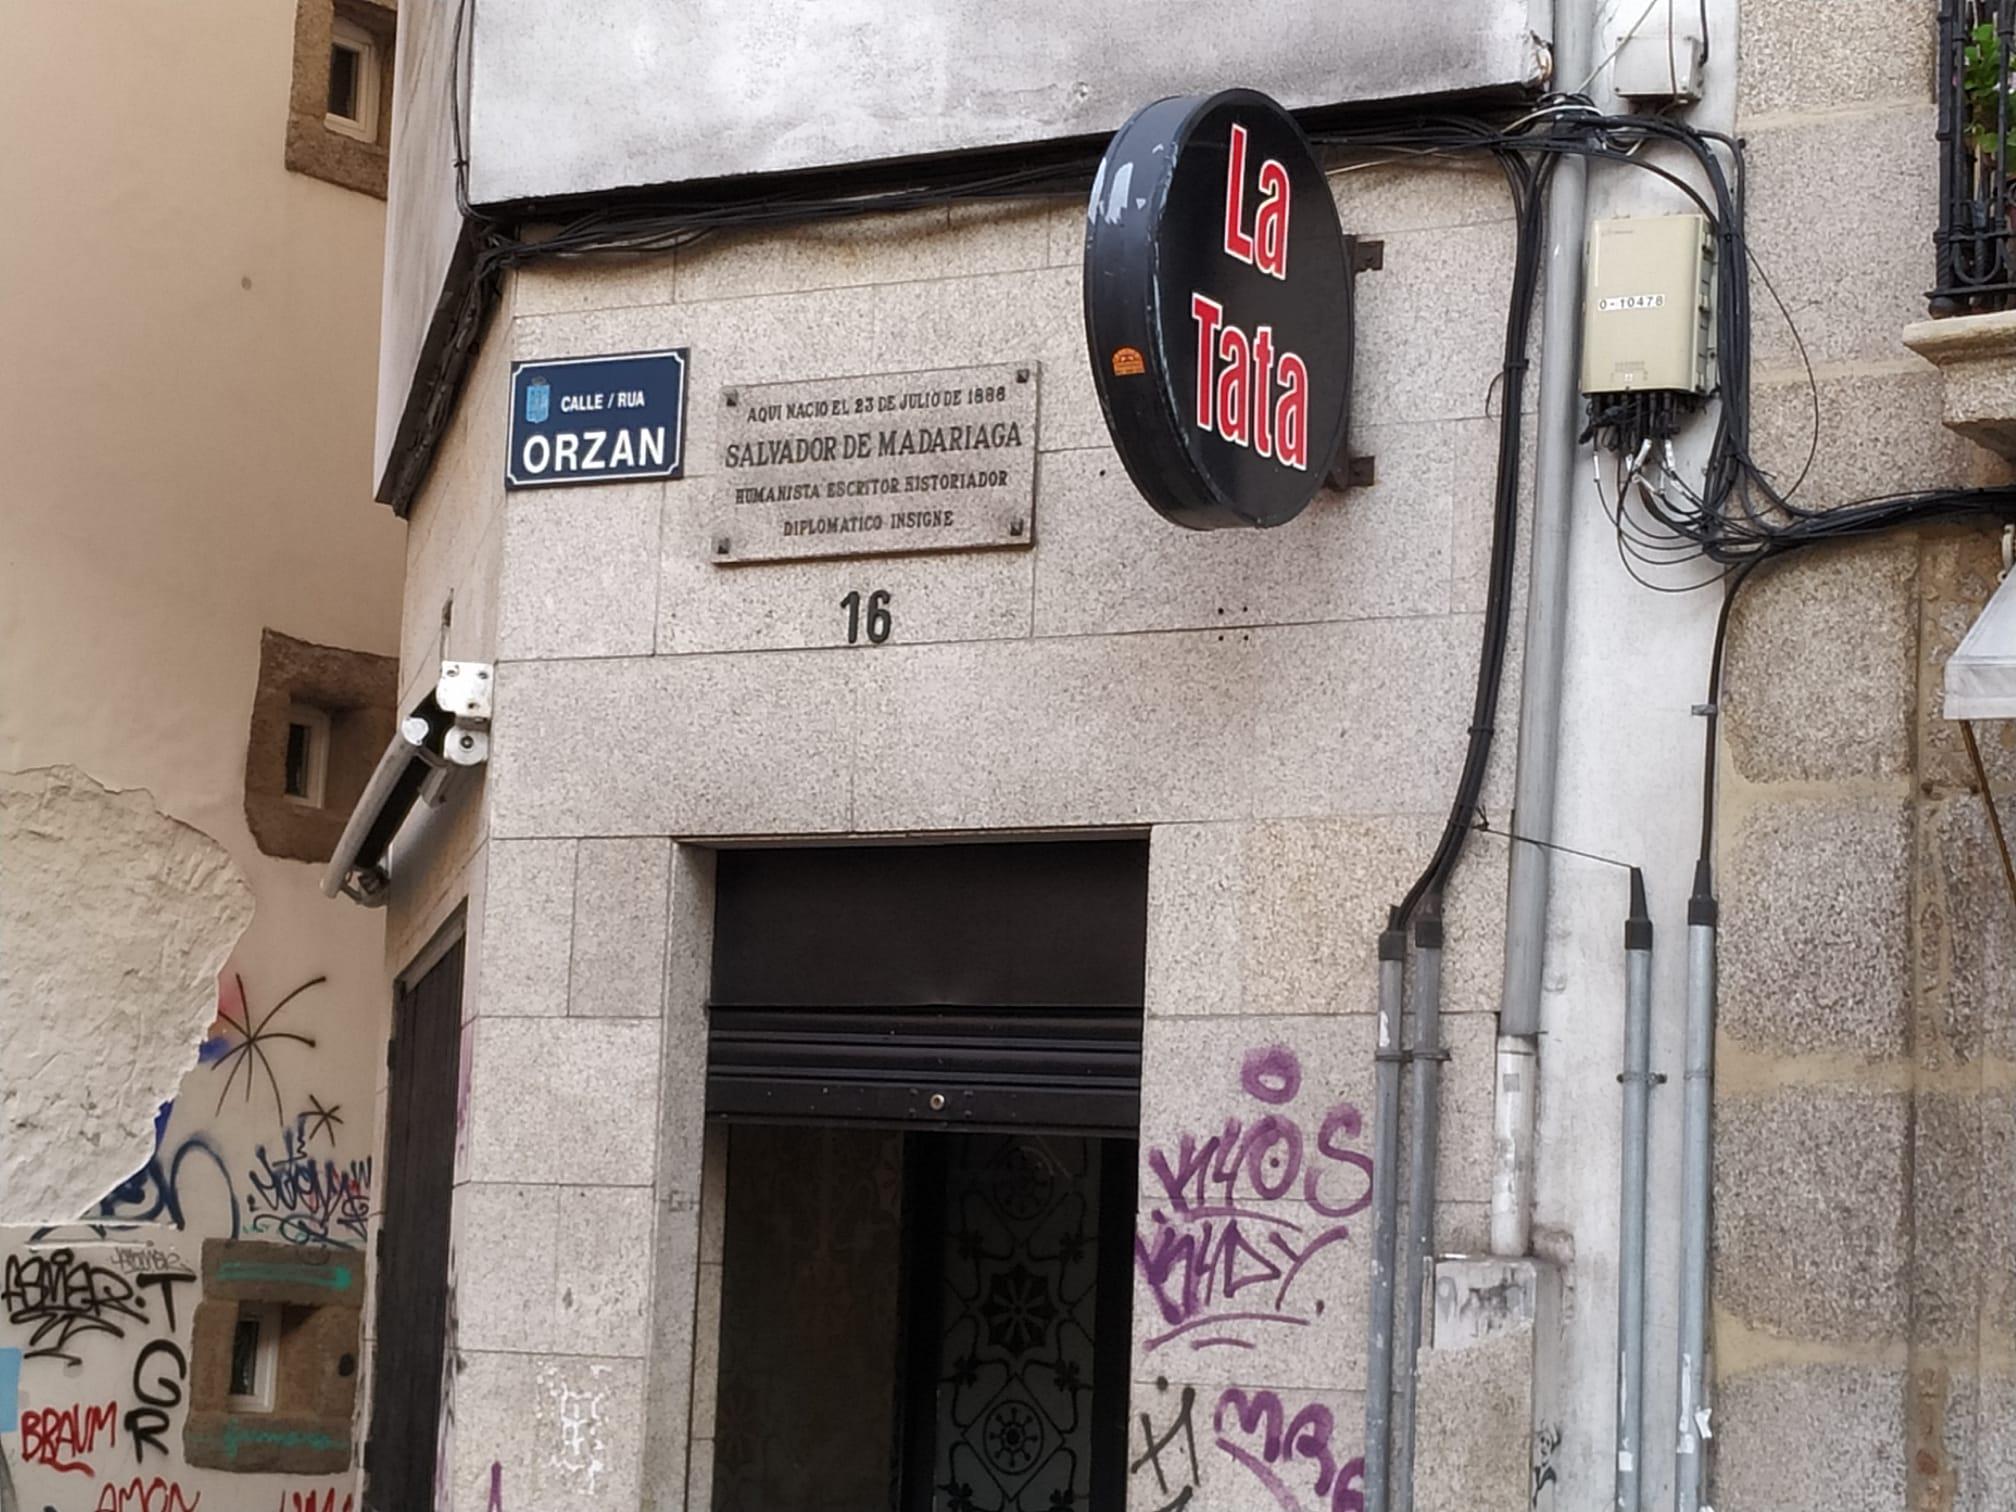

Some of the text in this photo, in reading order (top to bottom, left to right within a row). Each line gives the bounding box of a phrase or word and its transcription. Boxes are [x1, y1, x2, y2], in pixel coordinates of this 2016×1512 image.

[1224, 123, 1290, 280] La
[561, 394, 604, 412] CALLE
[617, 390, 645, 408] RUA
[1191, 292, 1309, 471] Tata
[747, 405, 782, 422] AQUI
[786, 400, 828, 419] NACIO
[832, 399, 849, 415] EL
[855, 396, 874, 413] 23
[878, 395, 896, 412] DE
[899, 391, 940, 410] JULIO
[944, 389, 962, 406] DE
[523, 427, 665, 474] ORZAN
[725, 421, 1022, 468] SALVADOR DE MADARIAGA
[735, 470, 1008, 504] HUMANISTA ESCRITOR HISTORIADOR
[784, 510, 954, 536] DIPLOMATICO INSIGNE
[840, 590, 892, 644] 16
